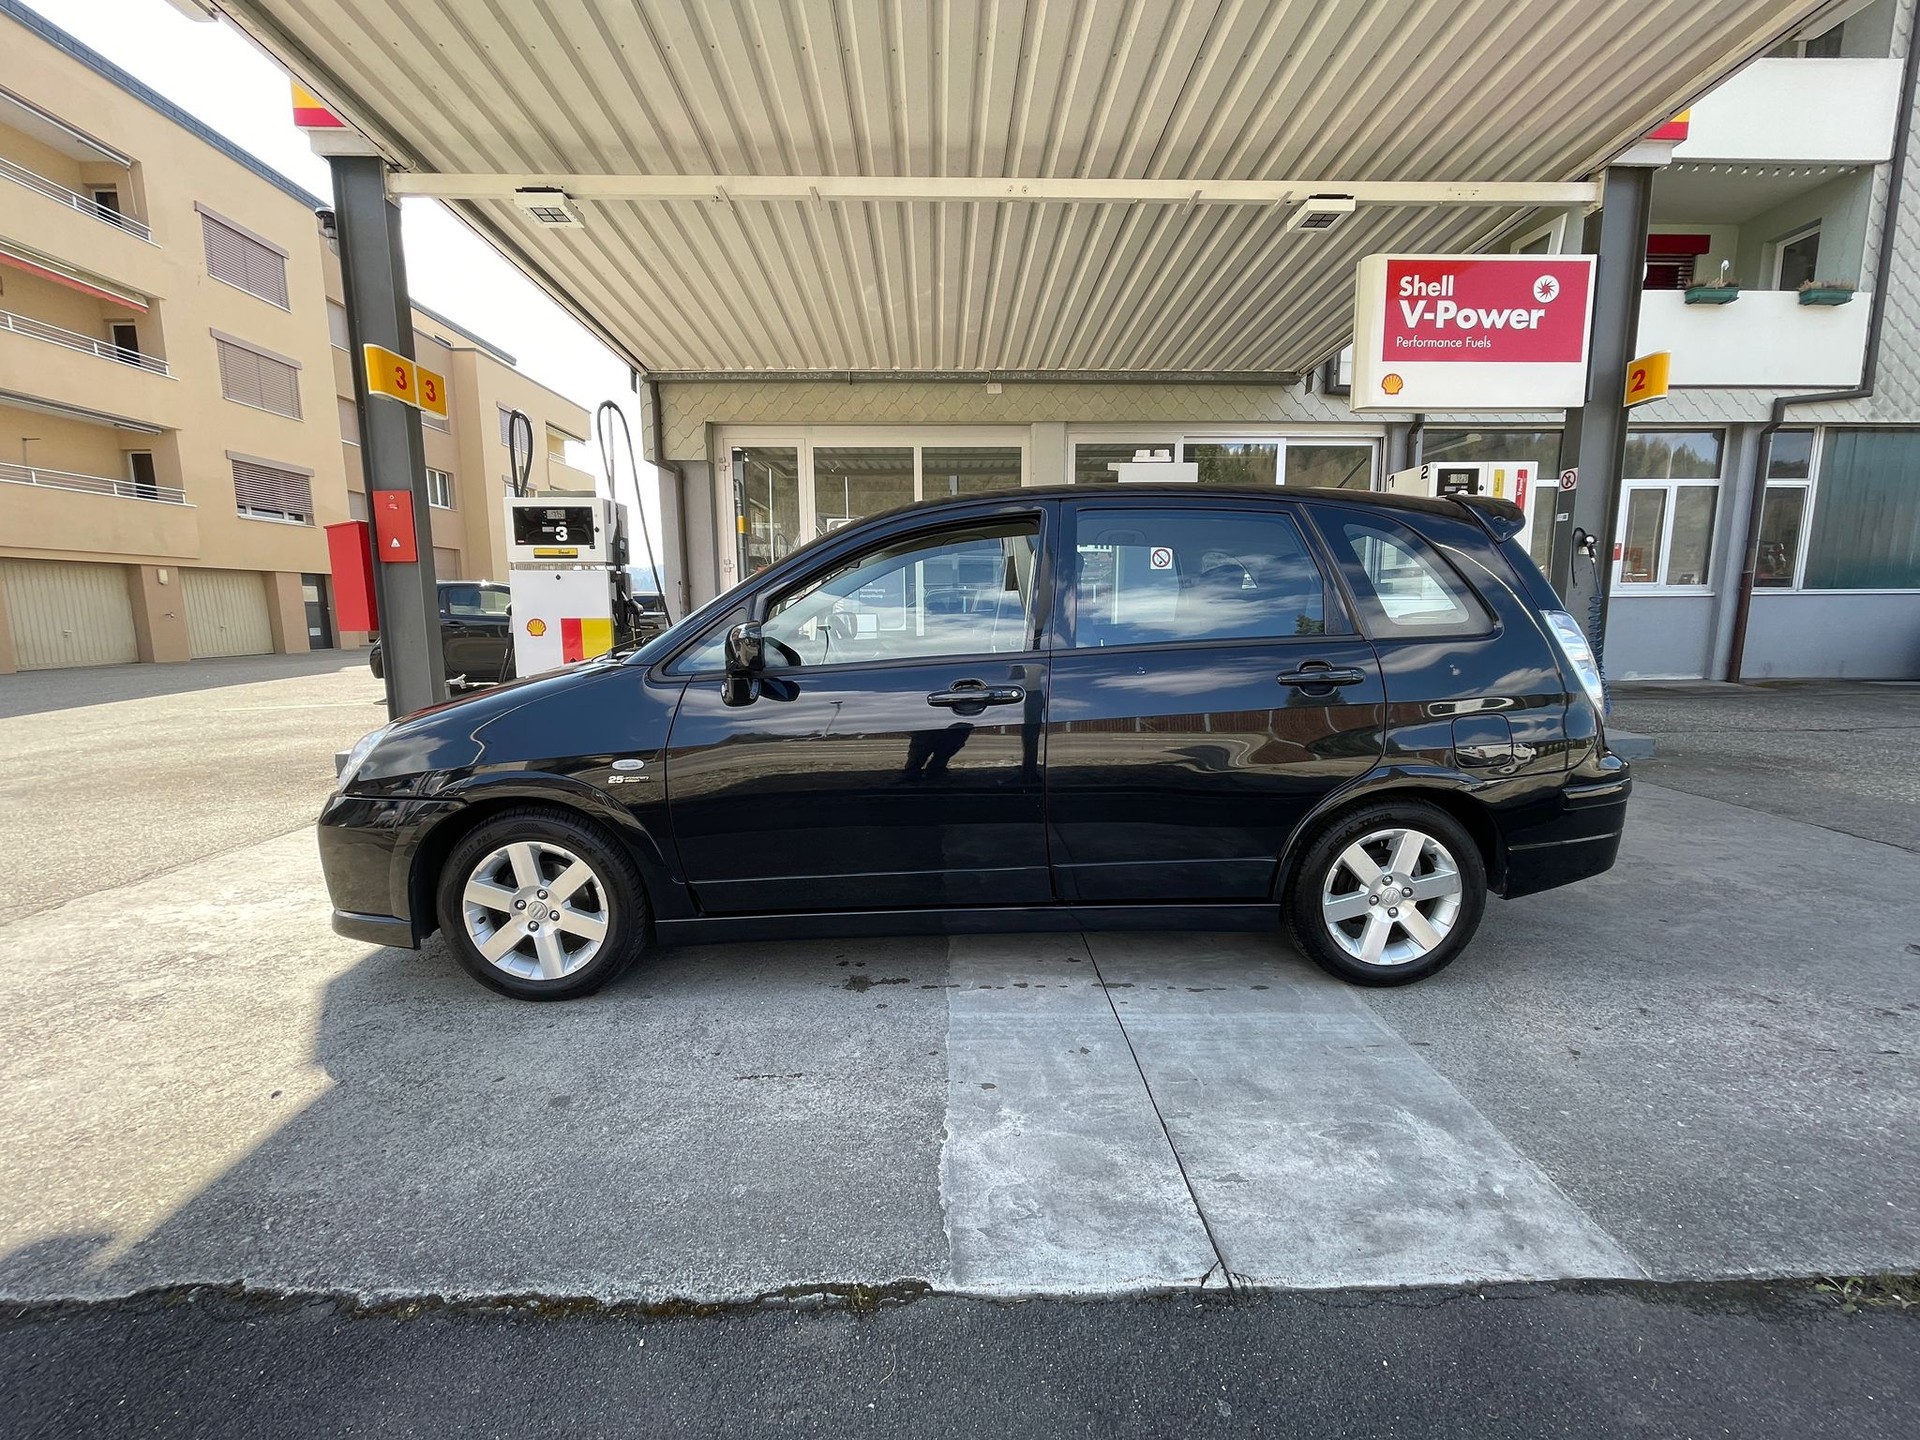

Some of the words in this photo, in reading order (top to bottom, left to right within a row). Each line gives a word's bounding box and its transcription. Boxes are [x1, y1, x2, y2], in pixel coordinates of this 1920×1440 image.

[1398, 274, 1454, 297] Shell
[1398, 299, 1546, 330] V-Power
[1396, 336, 1462, 348] Performance
[1465, 336, 1492, 348] Fuels
[395, 366, 407, 390] 3
[1630, 368, 1646, 393] 2
[425, 380, 436, 402] 3
[1388, 475, 1395, 488] 1
[1420, 465, 1429, 480] 2
[555, 526, 568, 542] 3
[608, 775, 624, 784] 25
[453, 844, 475, 870] SPIRIT
